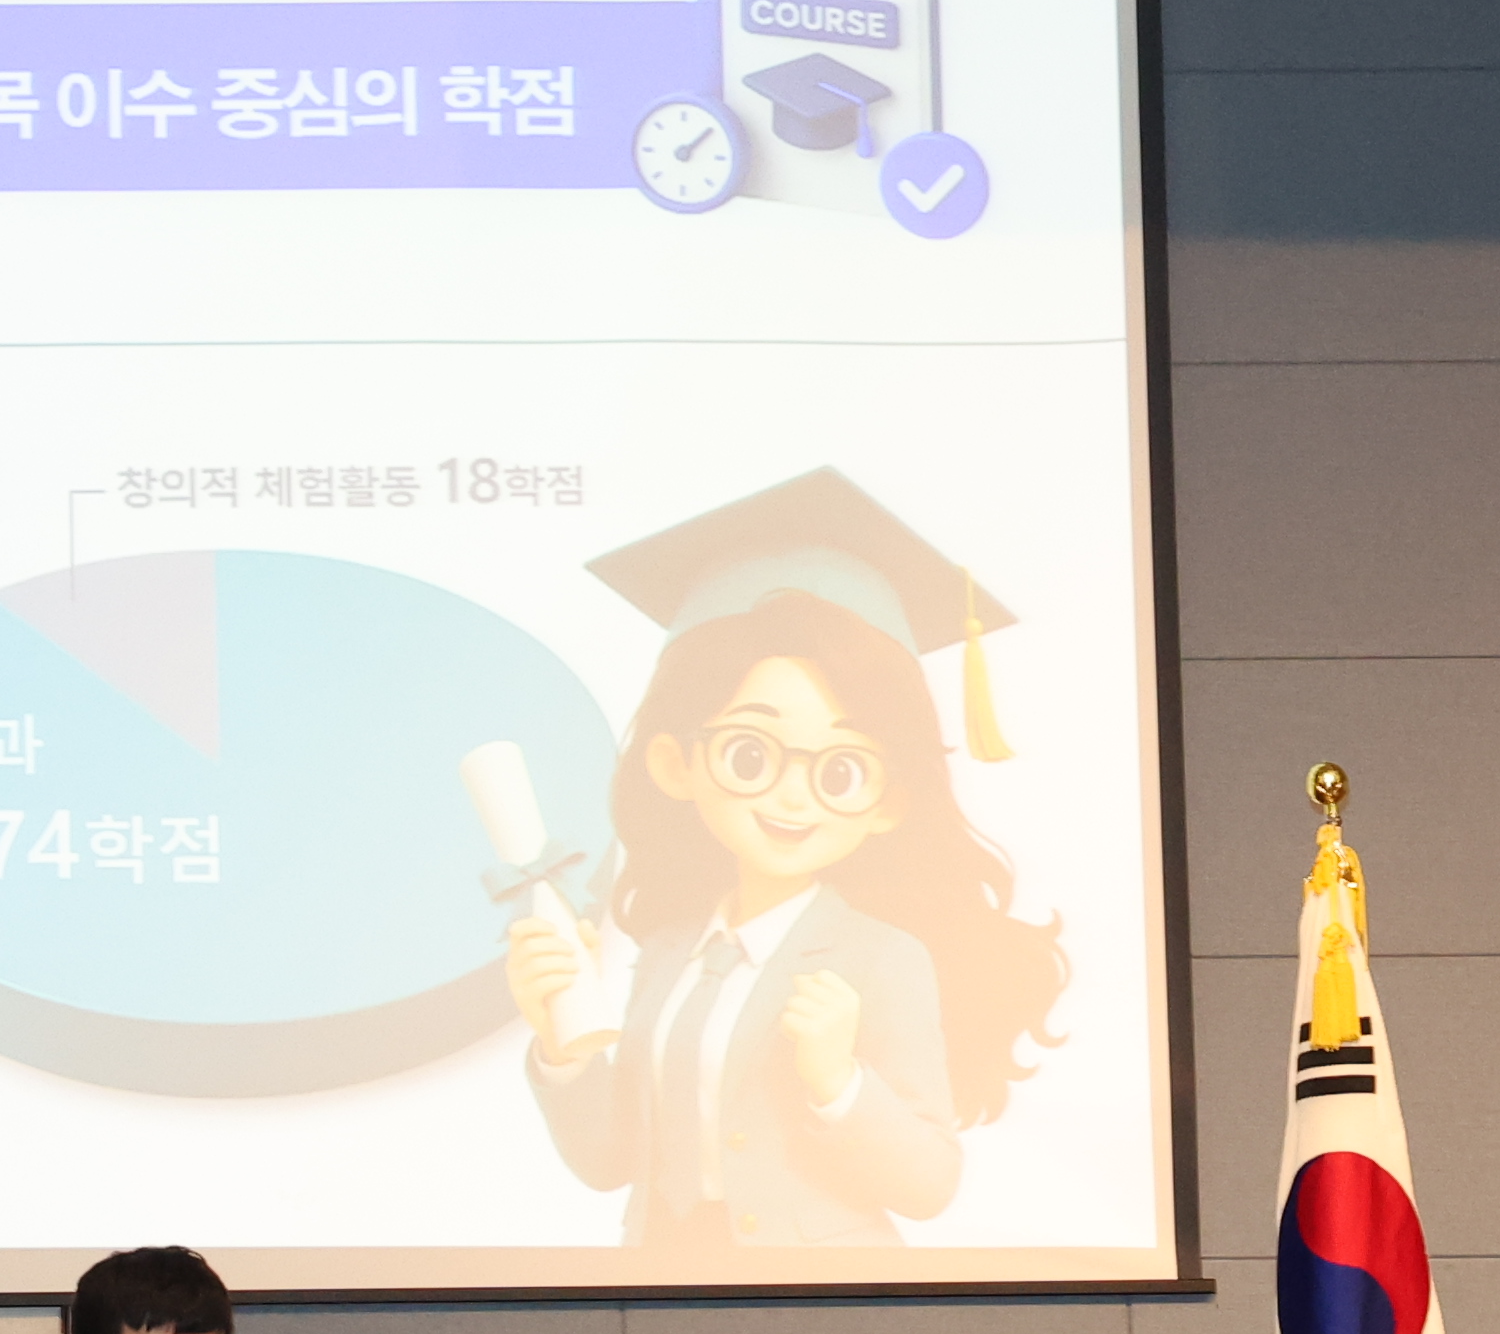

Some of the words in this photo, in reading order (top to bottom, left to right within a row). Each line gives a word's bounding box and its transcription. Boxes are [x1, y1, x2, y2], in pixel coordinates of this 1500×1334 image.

[56, 68, 198, 139] 이수
[211, 66, 419, 140] 중심의
[439, 65, 576, 137] 학점
[116, 466, 239, 510] 창의적
[254, 465, 422, 509] 체험활동
[437, 456, 584, 507] 18학점
